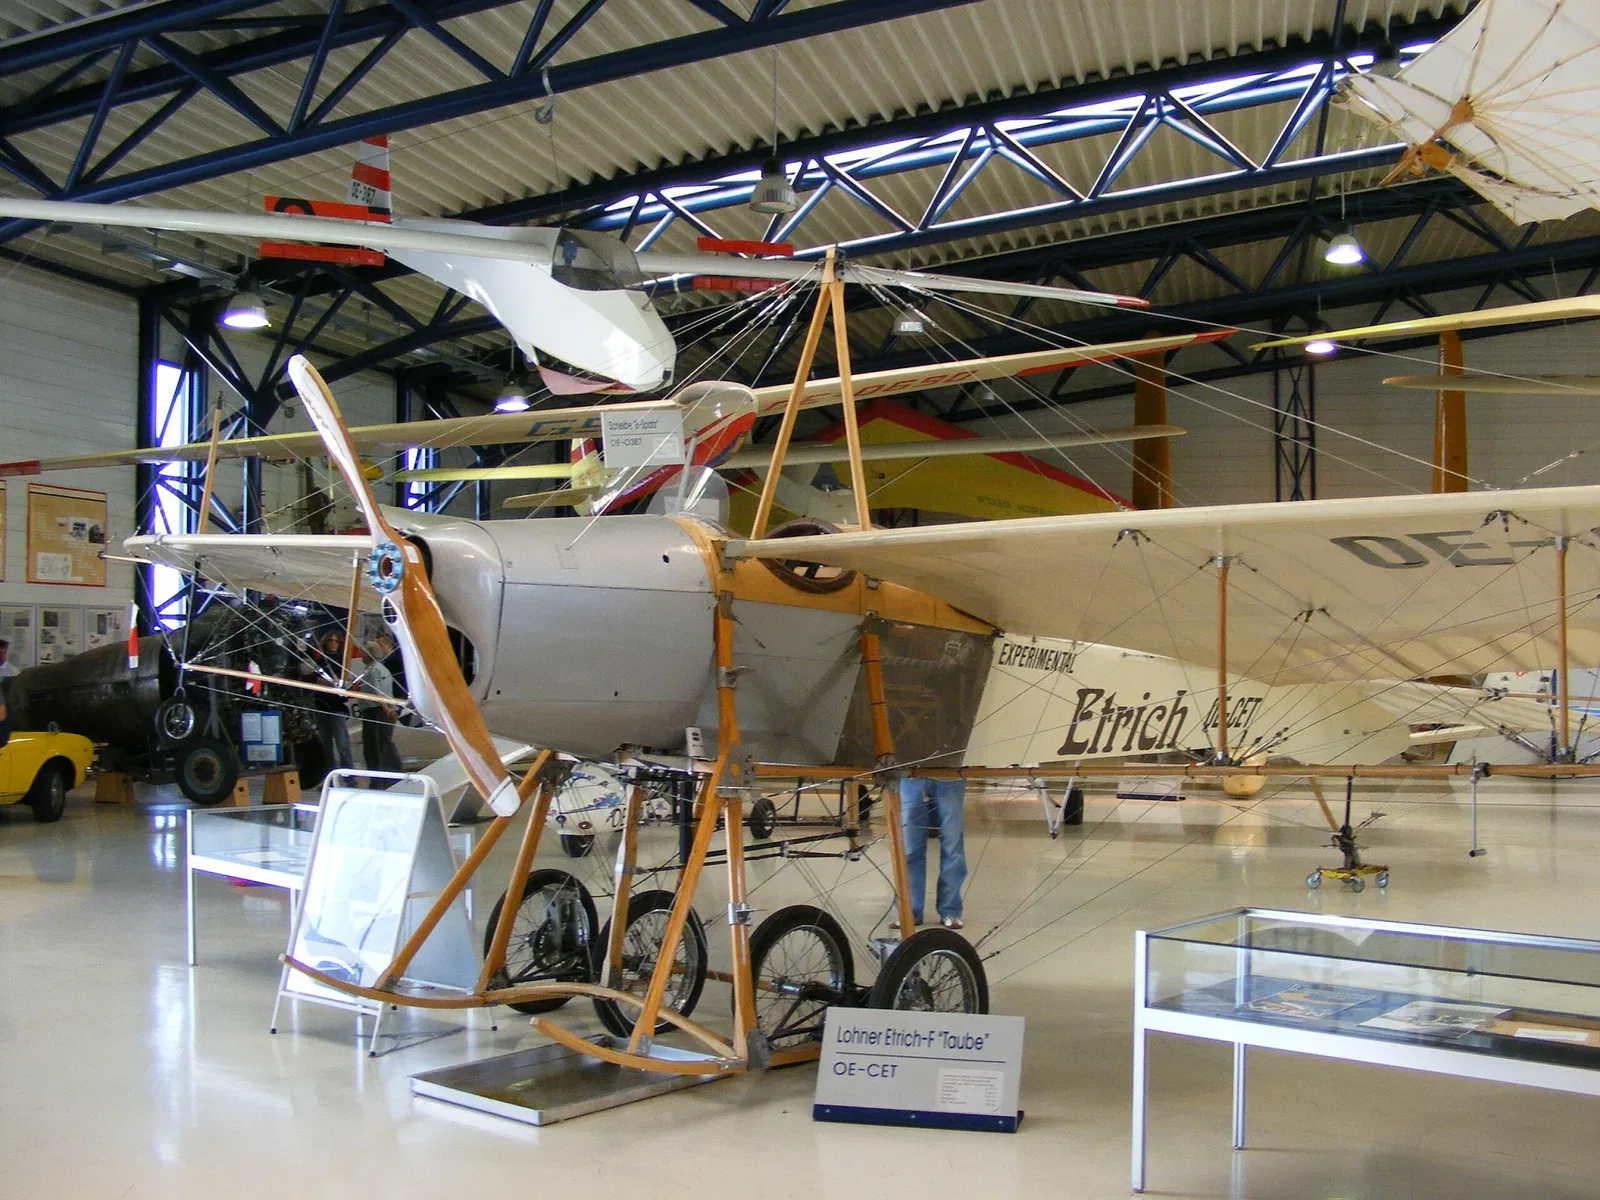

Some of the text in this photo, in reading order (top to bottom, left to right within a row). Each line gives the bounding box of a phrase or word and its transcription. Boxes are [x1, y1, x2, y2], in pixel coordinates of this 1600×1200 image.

[1329, 529, 1600, 570] OE-
[998, 643, 1076, 674] EXPERIMENTAL
[1056, 688, 1189, 756] Etrich
[837, 1026, 990, 1051] Lohner Etrich-F "Taube"
[833, 1061, 898, 1078] OE-CET
